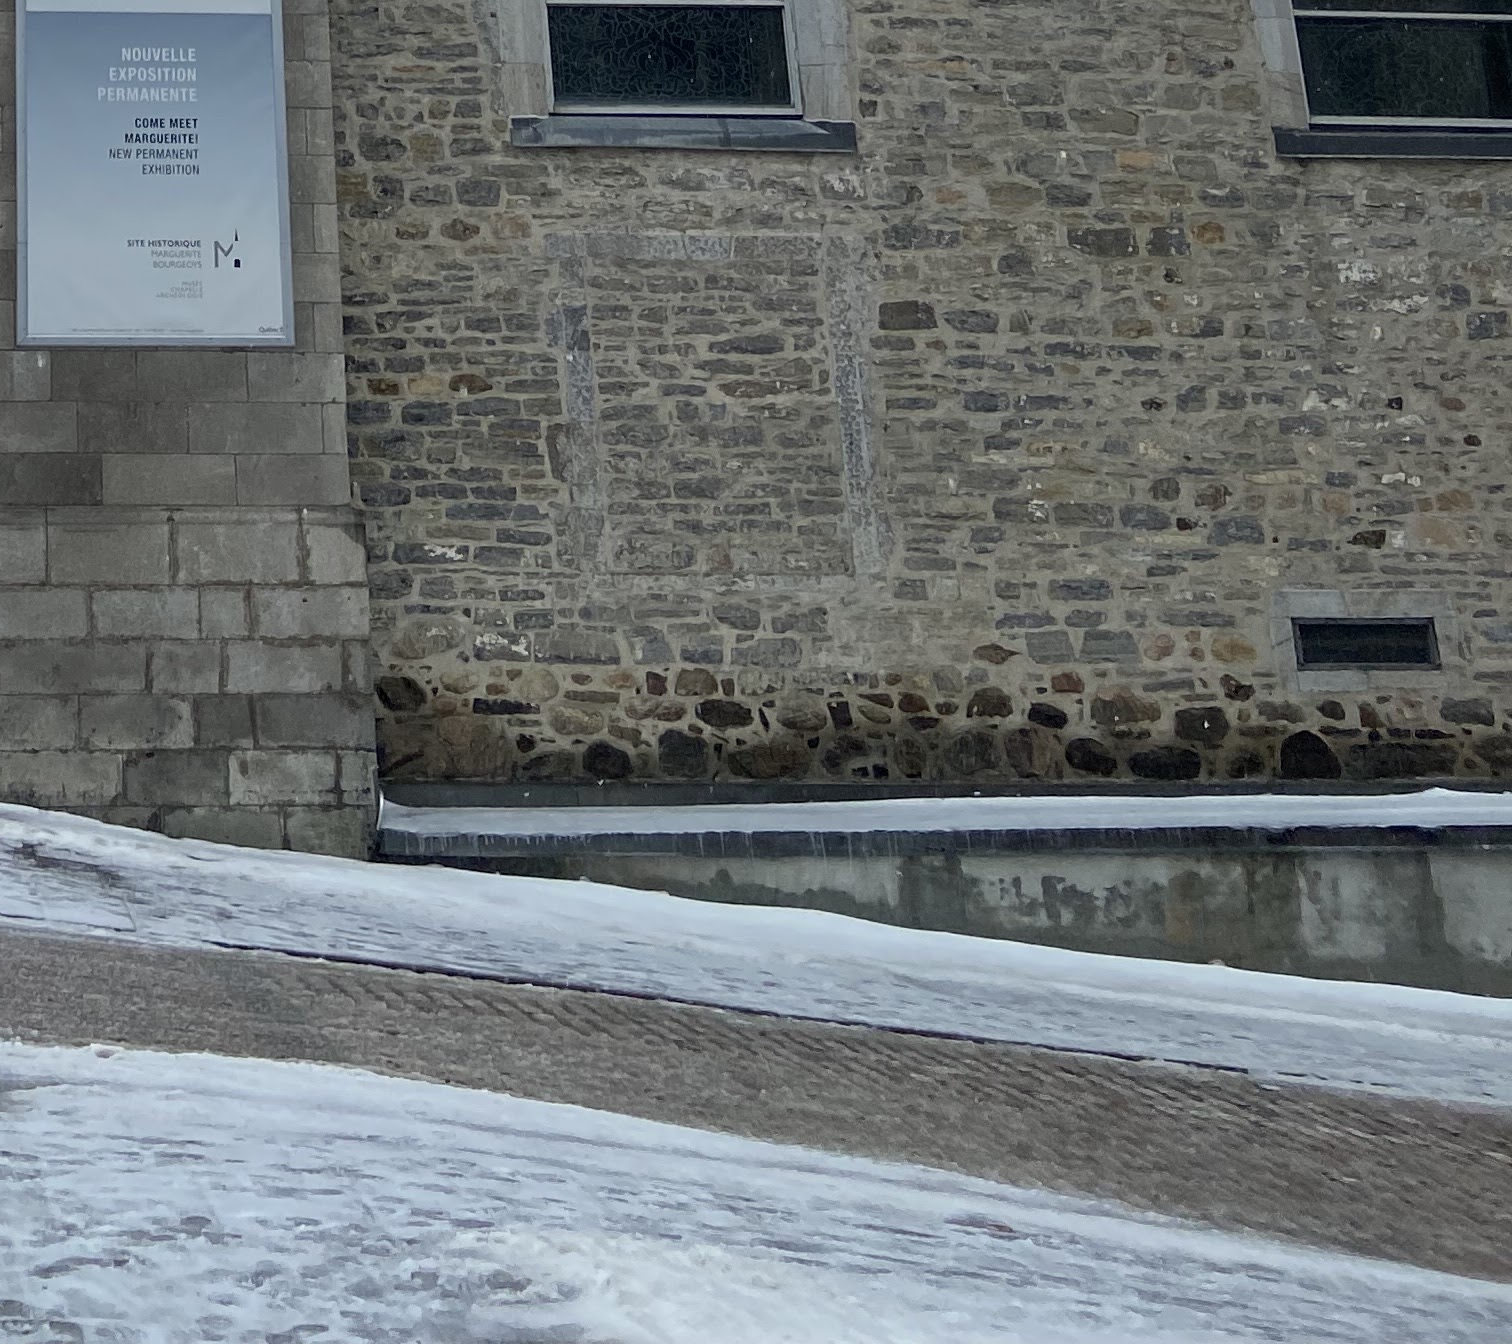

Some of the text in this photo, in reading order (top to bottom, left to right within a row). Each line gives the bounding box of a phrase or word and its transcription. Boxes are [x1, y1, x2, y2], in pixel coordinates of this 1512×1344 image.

[121, 47, 197, 62] NOUVELLE
[109, 67, 197, 82] EXPOSITION
[97, 87, 198, 102] PERMANENTE
[134, 118, 199, 129] COME MEET
[124, 133, 199, 144] MARGUERITE!
[109, 148, 199, 160] NEW PERMANENT
[142, 164, 200, 175] EXHIBITION
[127, 239, 202, 249] SITE HISTORIQUE
[151, 250, 201, 259] MARGUERITE
[153, 260, 203, 269] BOURGEOYS
